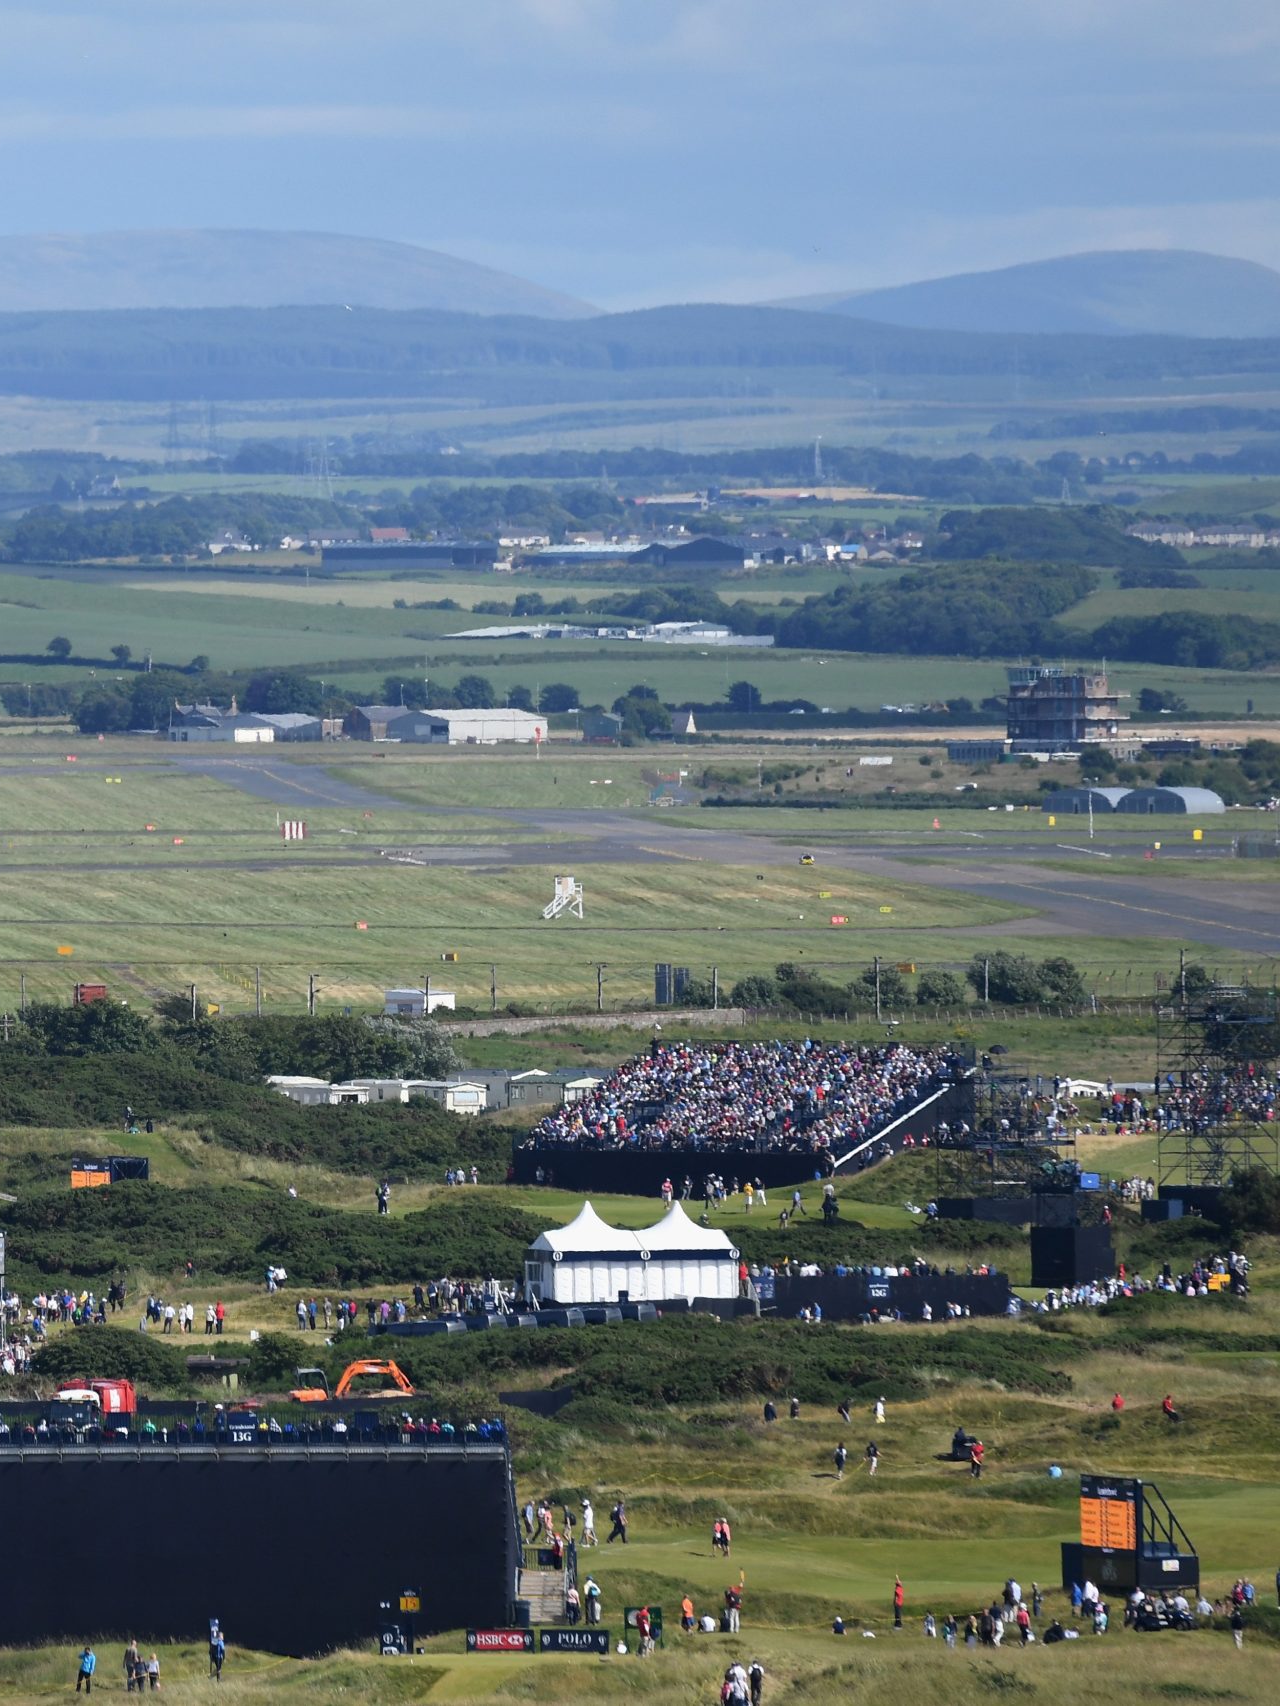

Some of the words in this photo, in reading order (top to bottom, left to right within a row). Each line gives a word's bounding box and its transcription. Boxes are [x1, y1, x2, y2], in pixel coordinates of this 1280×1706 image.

[232, 1431, 252, 1442] 13G
[476, 1633, 508, 1646] HSBC
[558, 1633, 592, 1645] POLO
